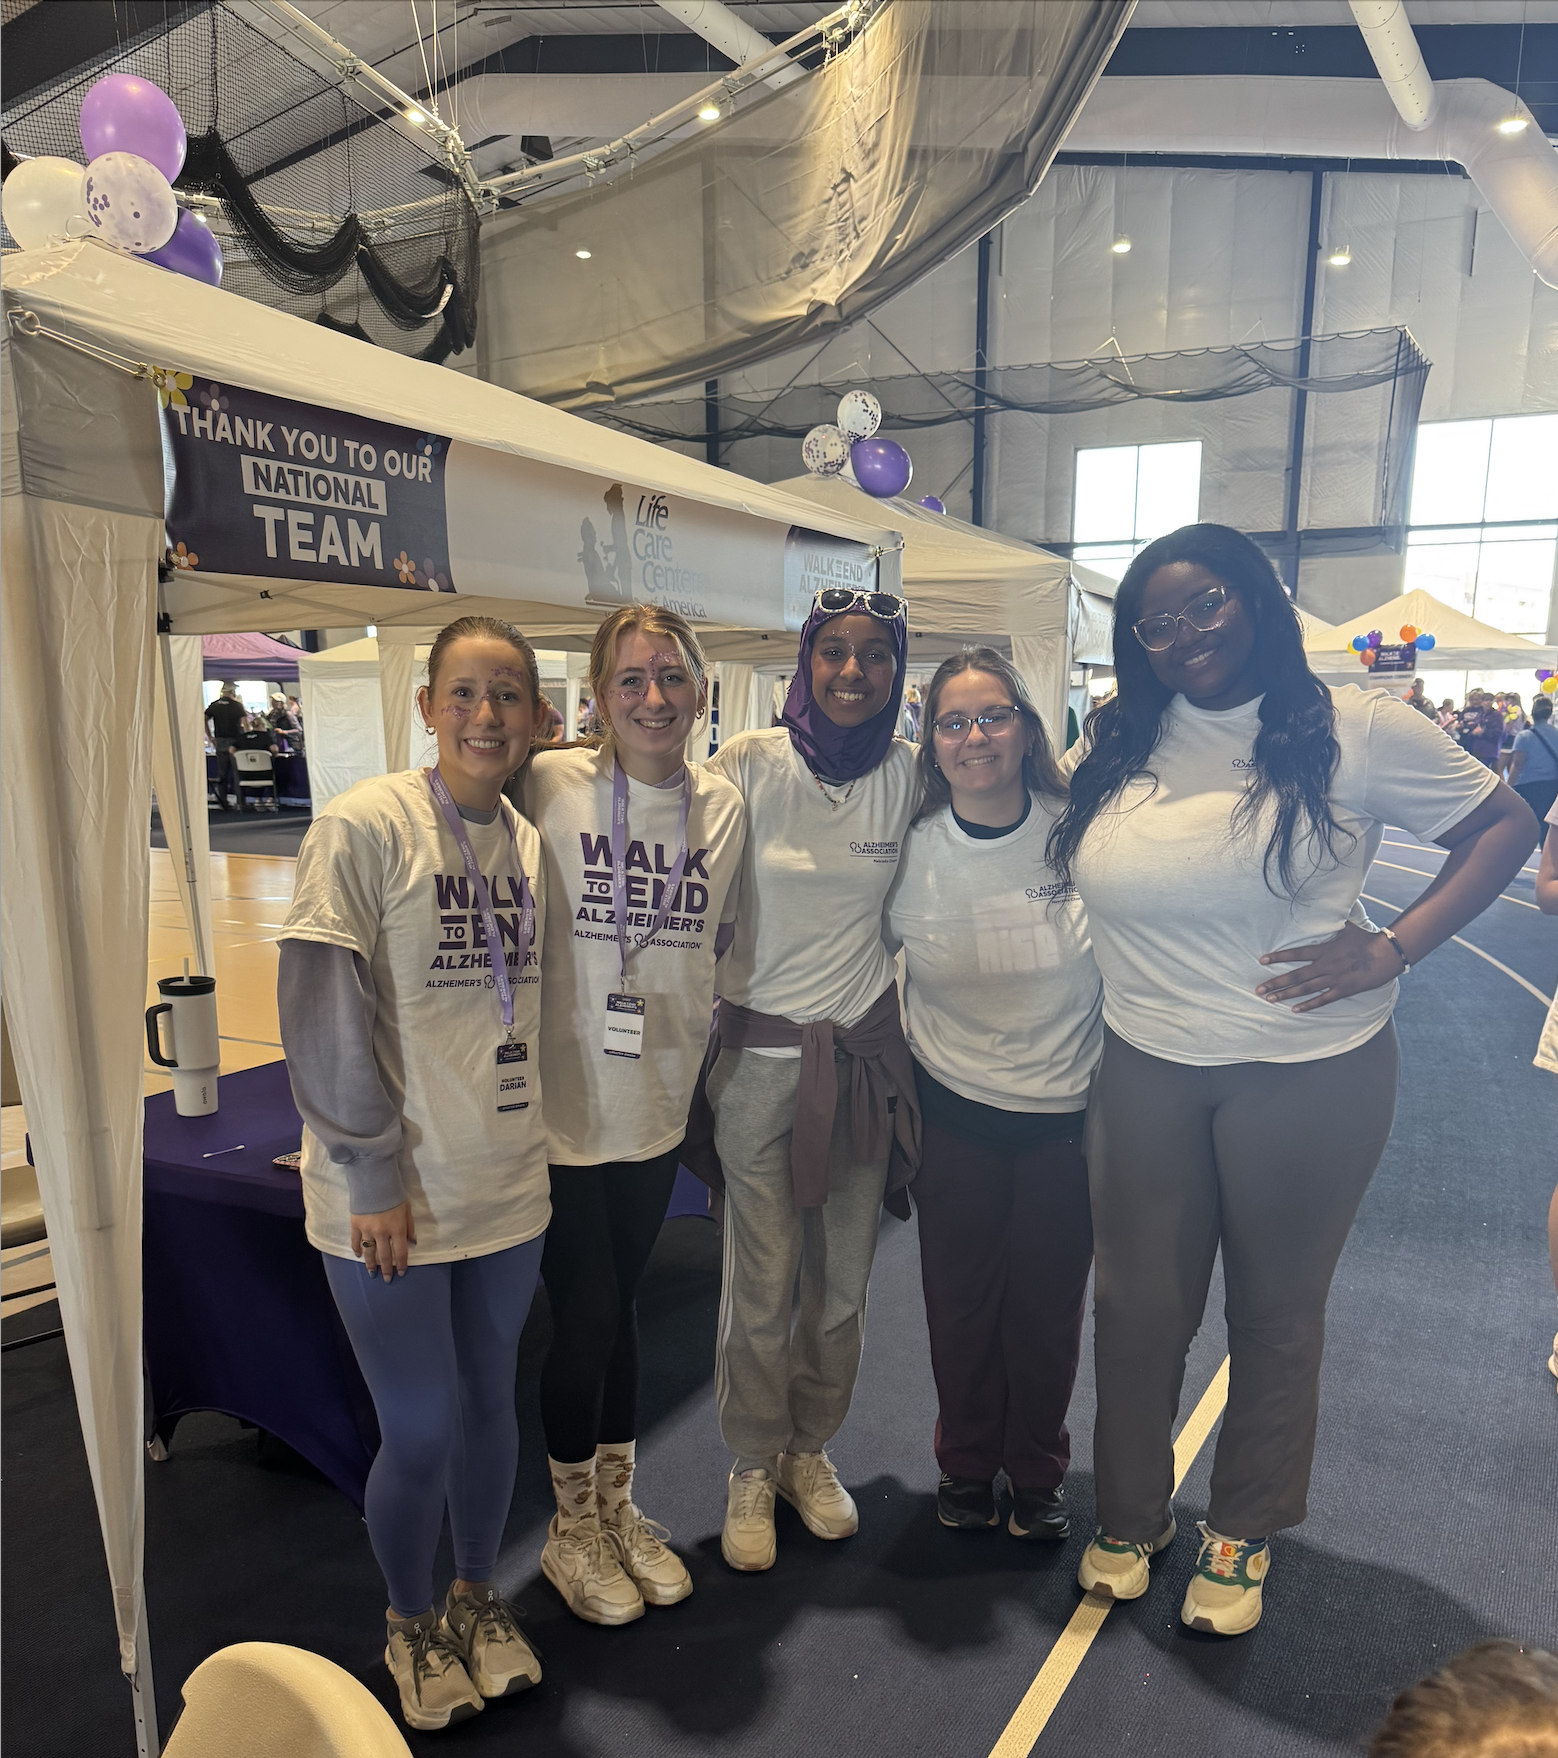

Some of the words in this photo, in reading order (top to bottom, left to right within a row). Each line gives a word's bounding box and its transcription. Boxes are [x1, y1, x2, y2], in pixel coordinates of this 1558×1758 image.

[171, 403, 275, 452] THANK
[280, 425, 337, 464] YOU
[343, 439, 377, 471] TO
[383, 450, 432, 483] OUR
[252, 462, 379, 509] NATIONAL
[635, 495, 669, 531] Life
[253, 504, 384, 570] TEAM
[633, 529, 673, 562] Care
[803, 552, 835, 577] WALK
[843, 561, 863, 582] END
[662, 595, 707, 619] America
[580, 832, 710, 880] WALK
[586, 880, 611, 894] TO
[626, 875, 709, 914] END
[1038, 887, 1079, 898] ASSOCIATIO
[443, 926, 465, 939] TO
[574, 929, 632, 944] ALZHEIME'S
[650, 938, 701, 949] ASSOCIATION
[429, 951, 538, 969] ALZHEMER'S
[425, 979, 481, 988] ALZHEIMER'S
[508, 976, 539, 985] SOCIATIO
[608, 1026, 641, 1035] VOLUNTEER
[500, 1081, 527, 1092] DARIAN
